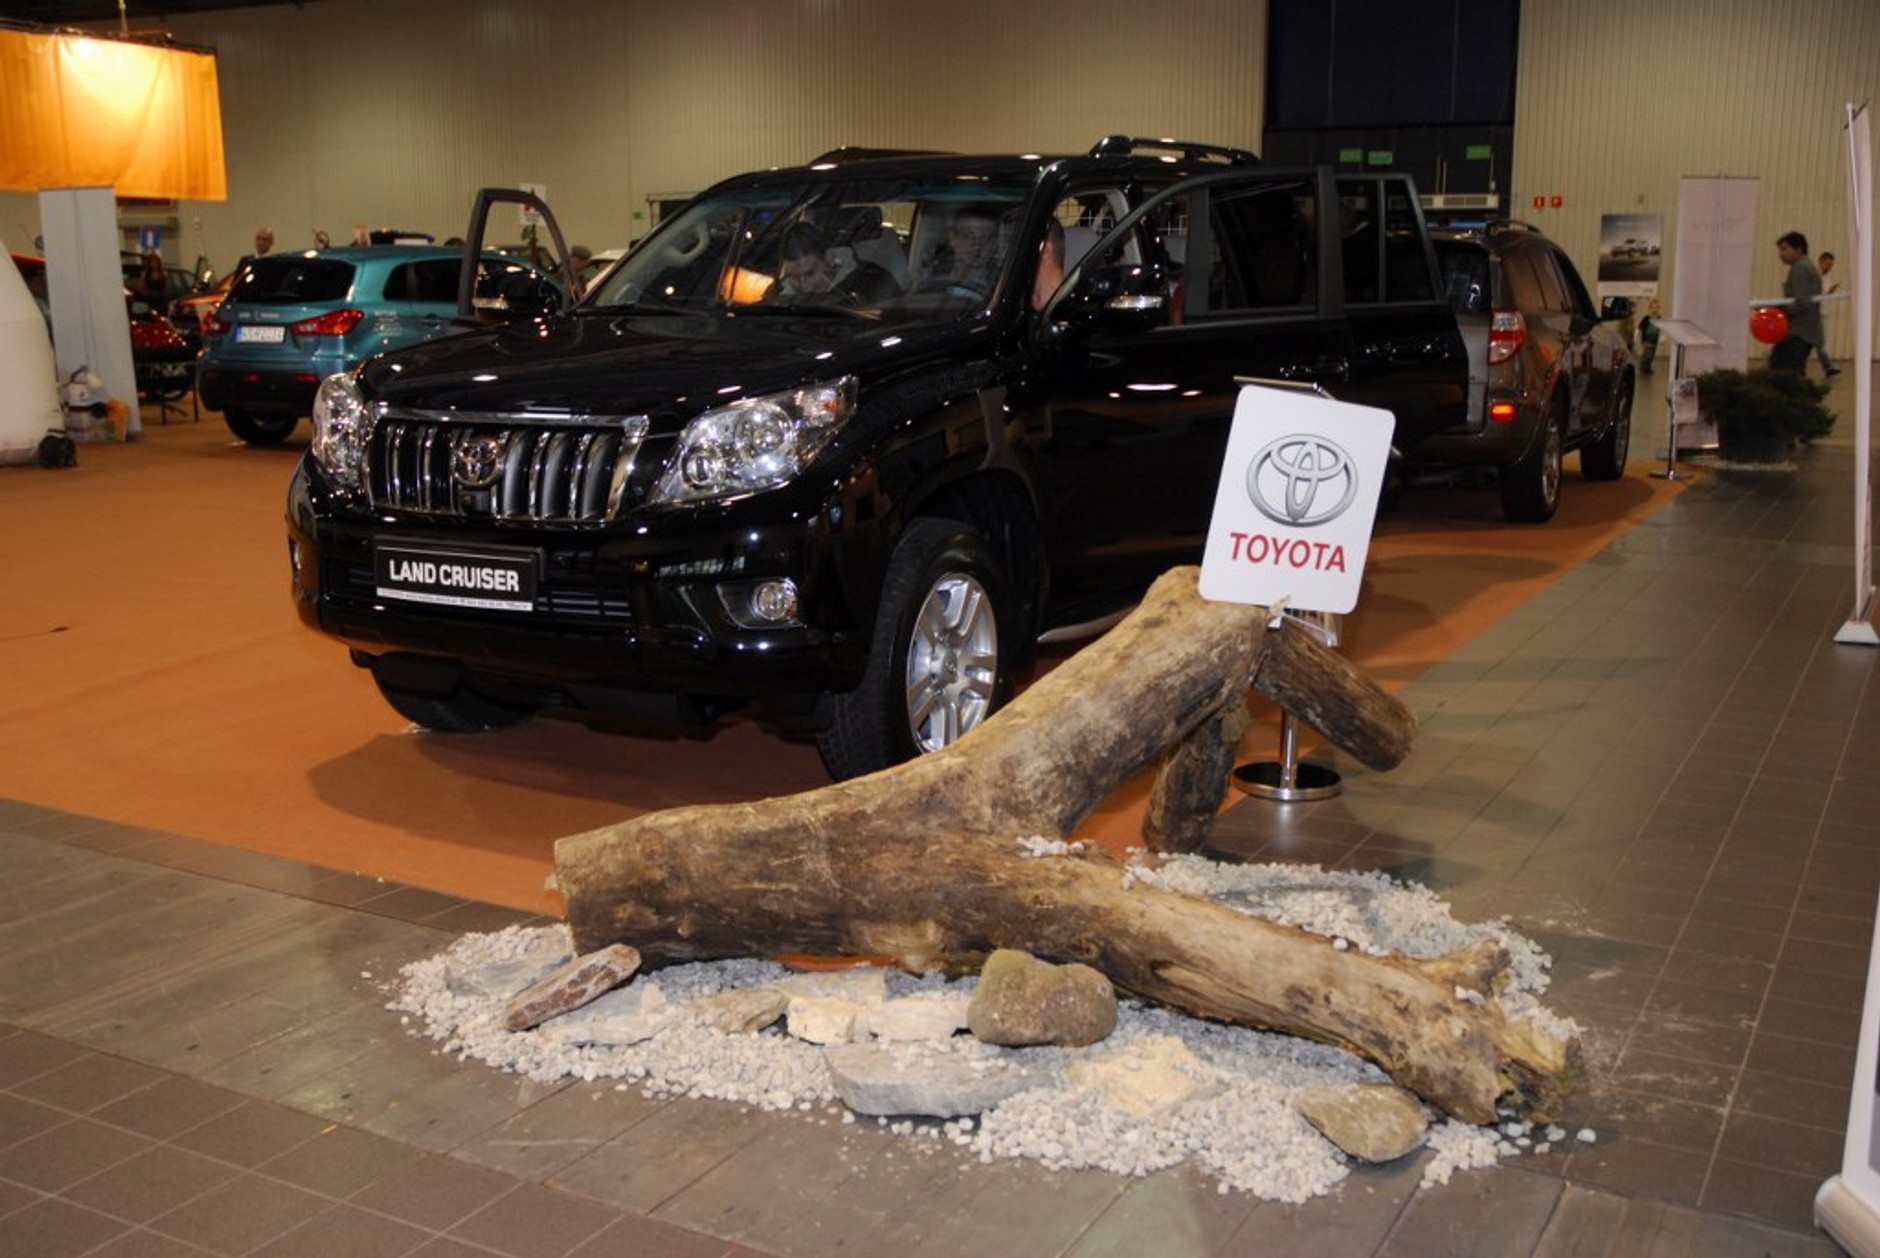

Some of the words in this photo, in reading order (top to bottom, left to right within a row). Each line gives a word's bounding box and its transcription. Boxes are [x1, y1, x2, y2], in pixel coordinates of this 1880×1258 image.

[1230, 532, 1346, 573] TOYOTA
[389, 559, 436, 584] LAND
[439, 564, 519, 592] CRUISER
